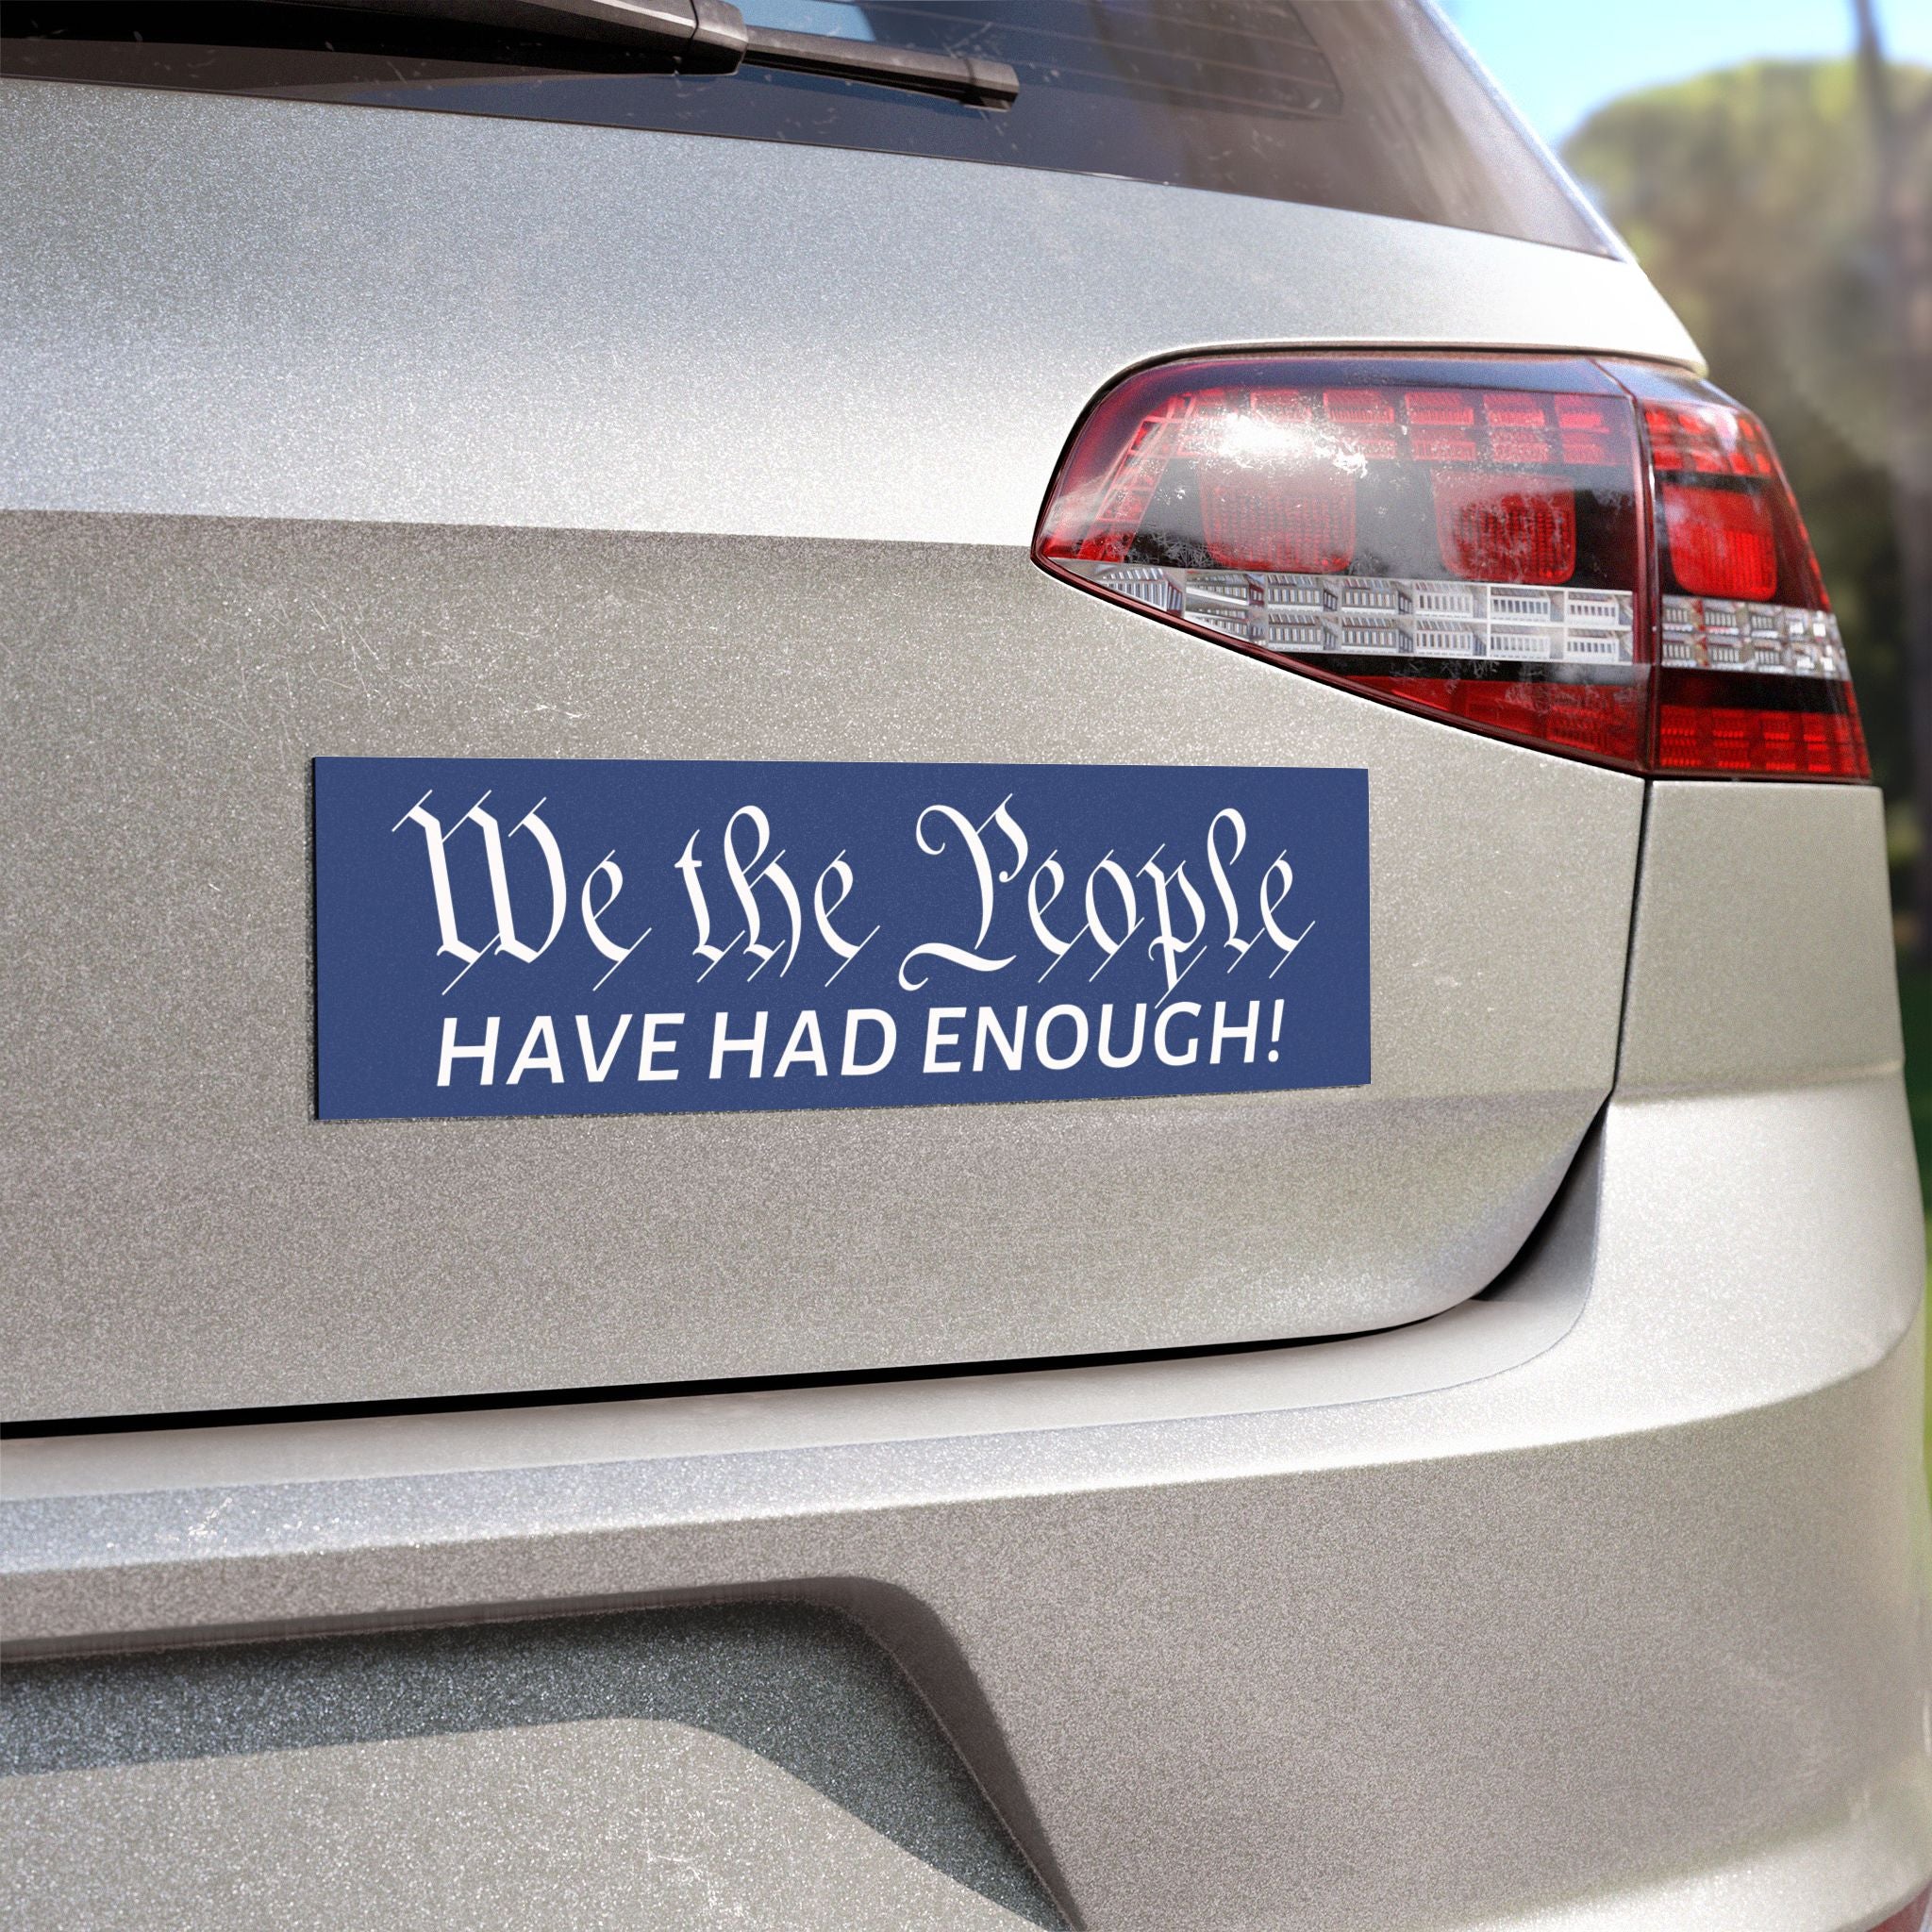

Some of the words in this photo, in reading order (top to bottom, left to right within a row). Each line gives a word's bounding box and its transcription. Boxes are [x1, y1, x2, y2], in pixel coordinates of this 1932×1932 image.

[391, 789, 653, 991] We
[674, 805, 881, 988] the
[898, 792, 1316, 1009] People
[436, 1012, 686, 1087] HAVE
[708, 1008, 897, 1079] HAD
[923, 998, 1285, 1074] ENOUGH!
